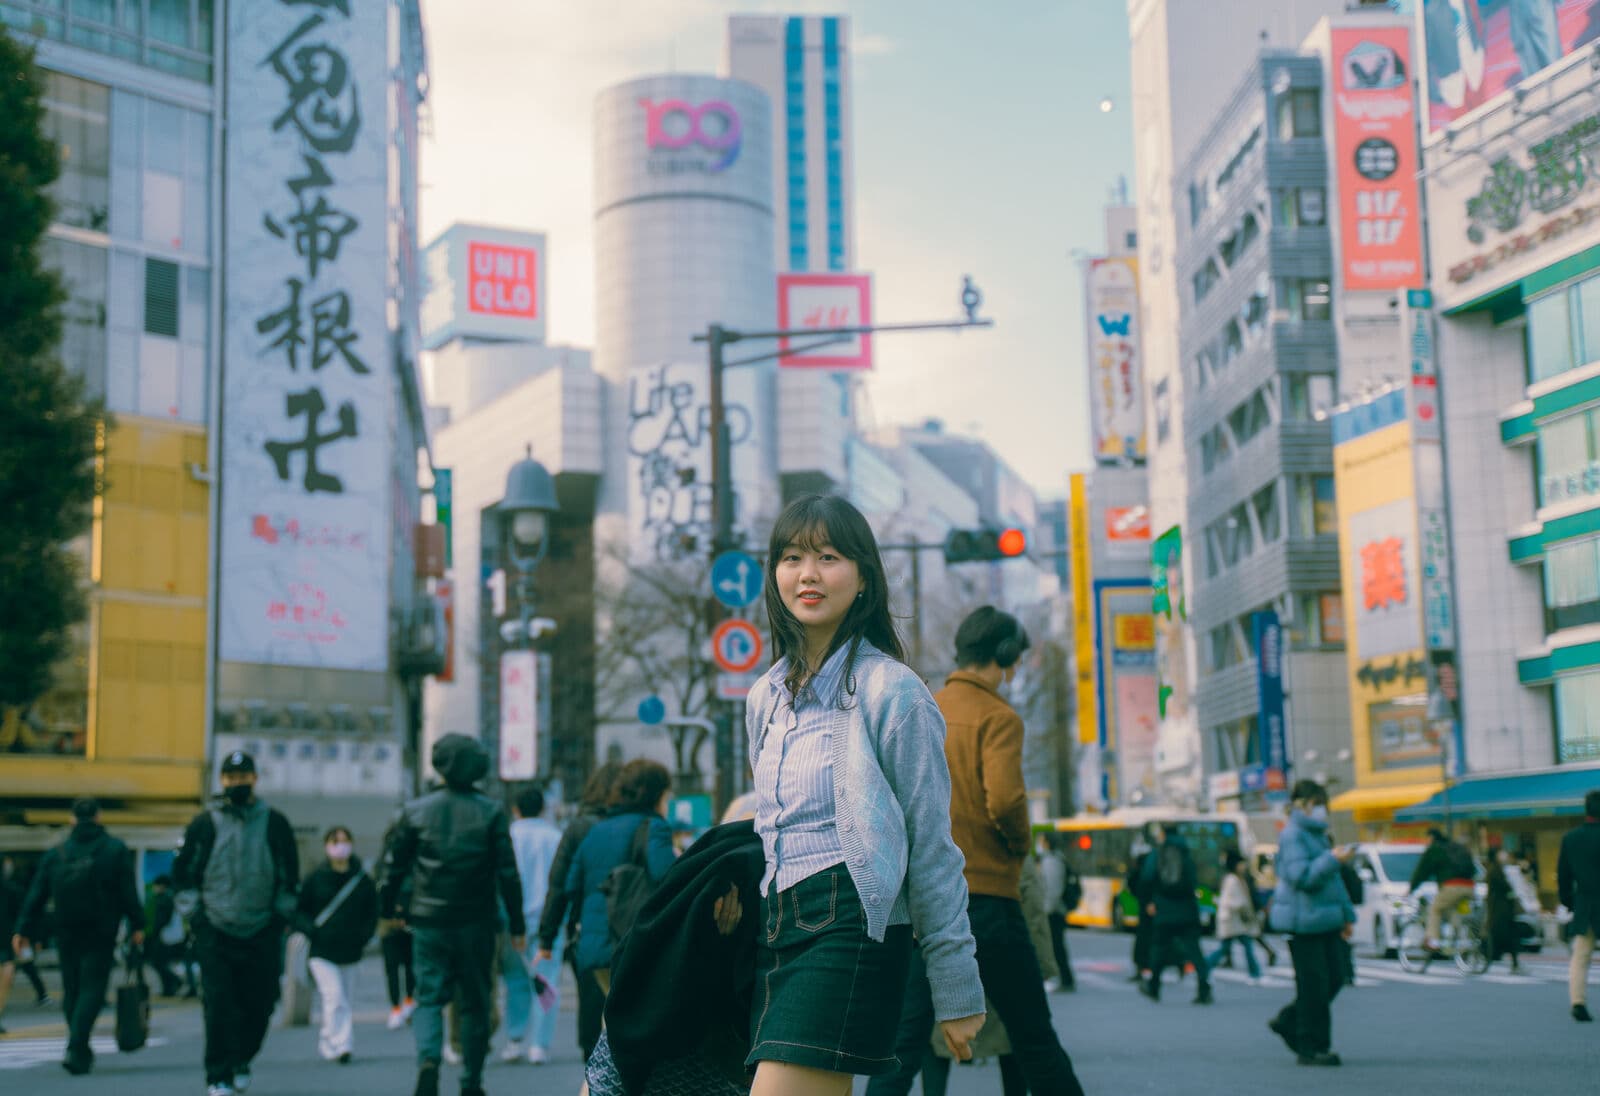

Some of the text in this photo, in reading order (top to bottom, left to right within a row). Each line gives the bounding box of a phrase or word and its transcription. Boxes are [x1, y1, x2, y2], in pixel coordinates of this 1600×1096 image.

[638, 97, 743, 173] 109
[256, 0, 371, 494] 鬼帝根卍
[474, 251, 527, 280] UNI
[474, 281, 531, 311] QLO
